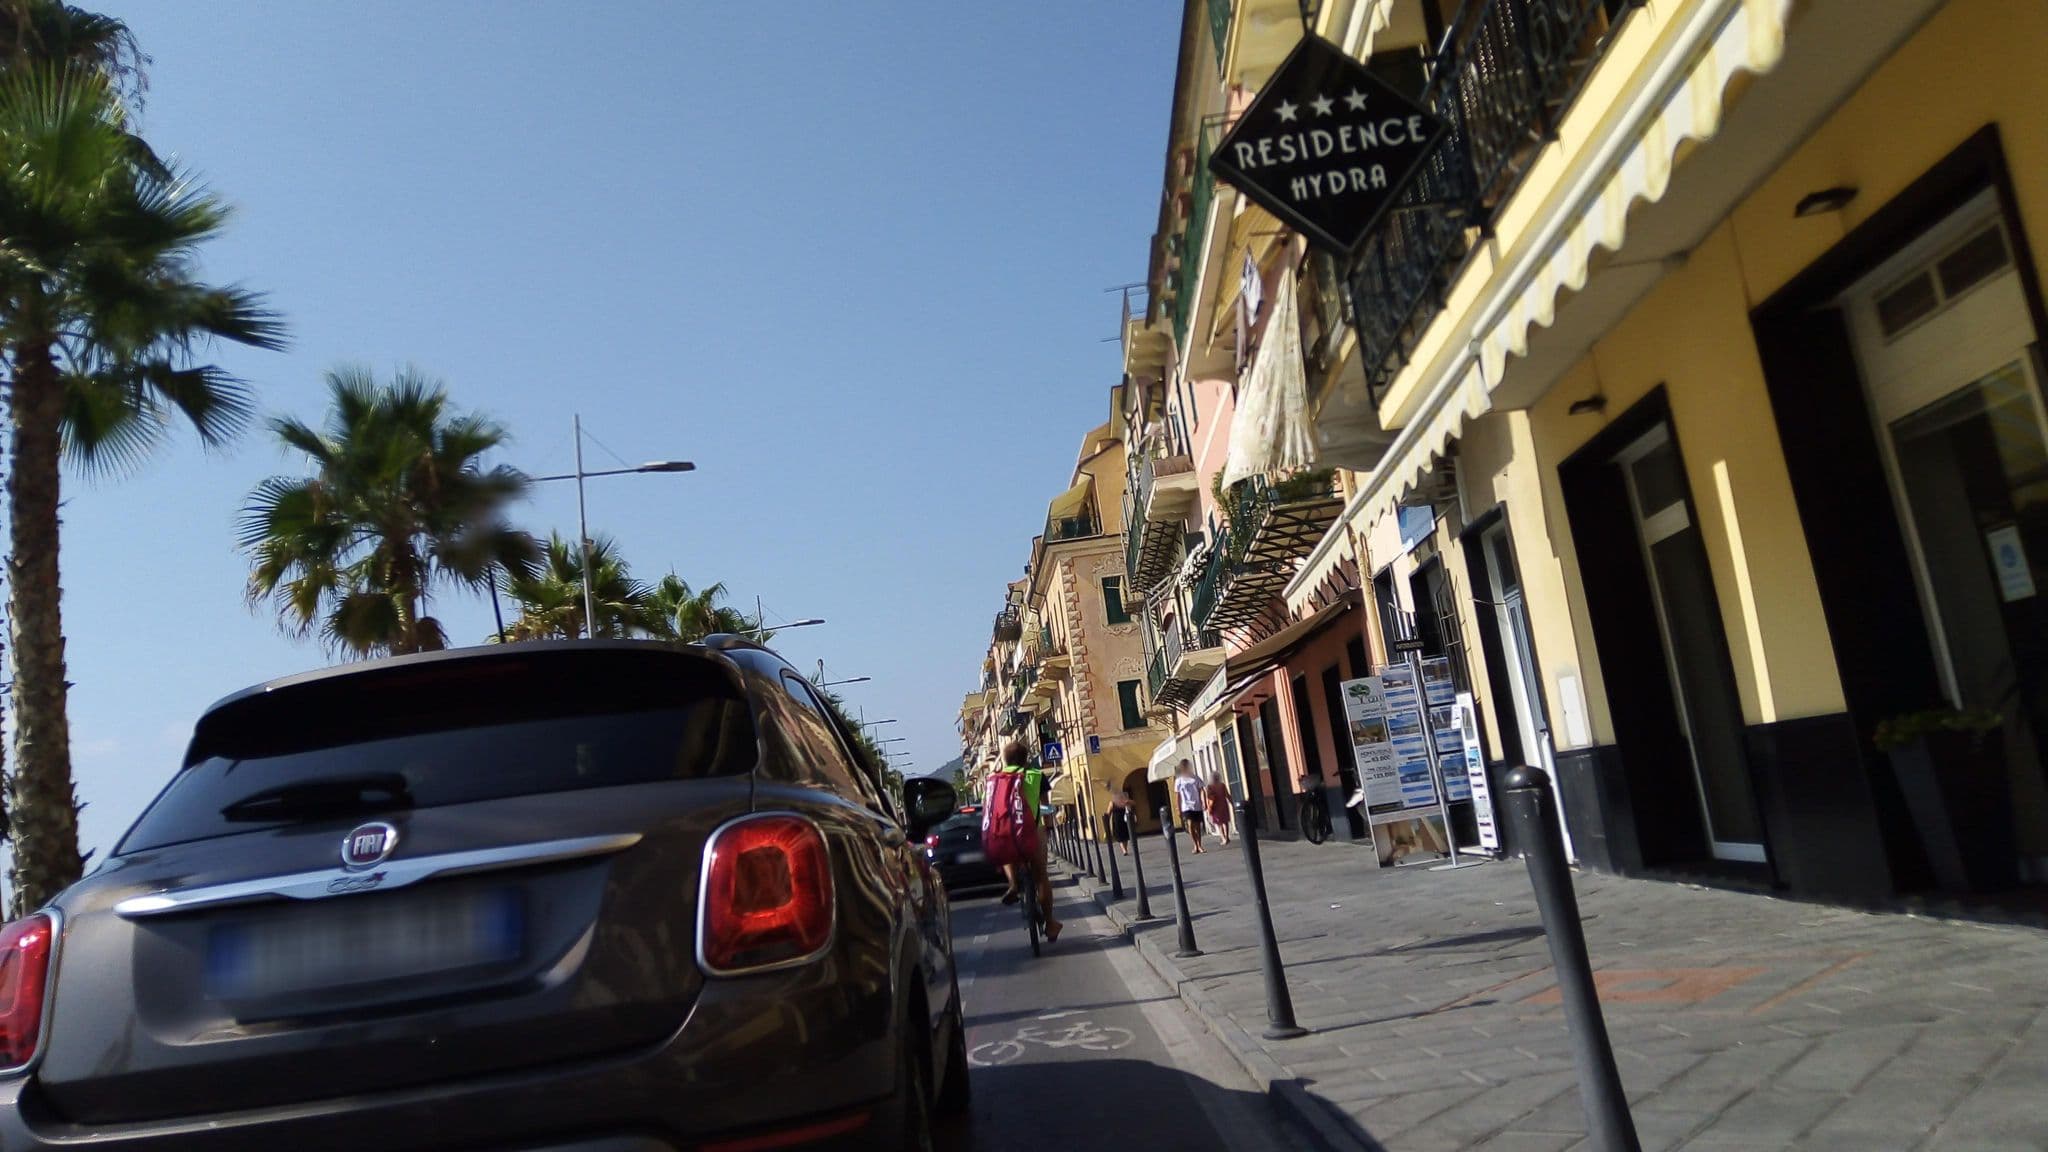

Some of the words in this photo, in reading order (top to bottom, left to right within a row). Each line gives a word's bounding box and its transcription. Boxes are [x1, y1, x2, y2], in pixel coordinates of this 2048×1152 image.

[1234, 115, 1426, 170] RESIDENCE
[1291, 164, 1387, 200] HYDRA
[353, 833, 385, 856] FIAT
